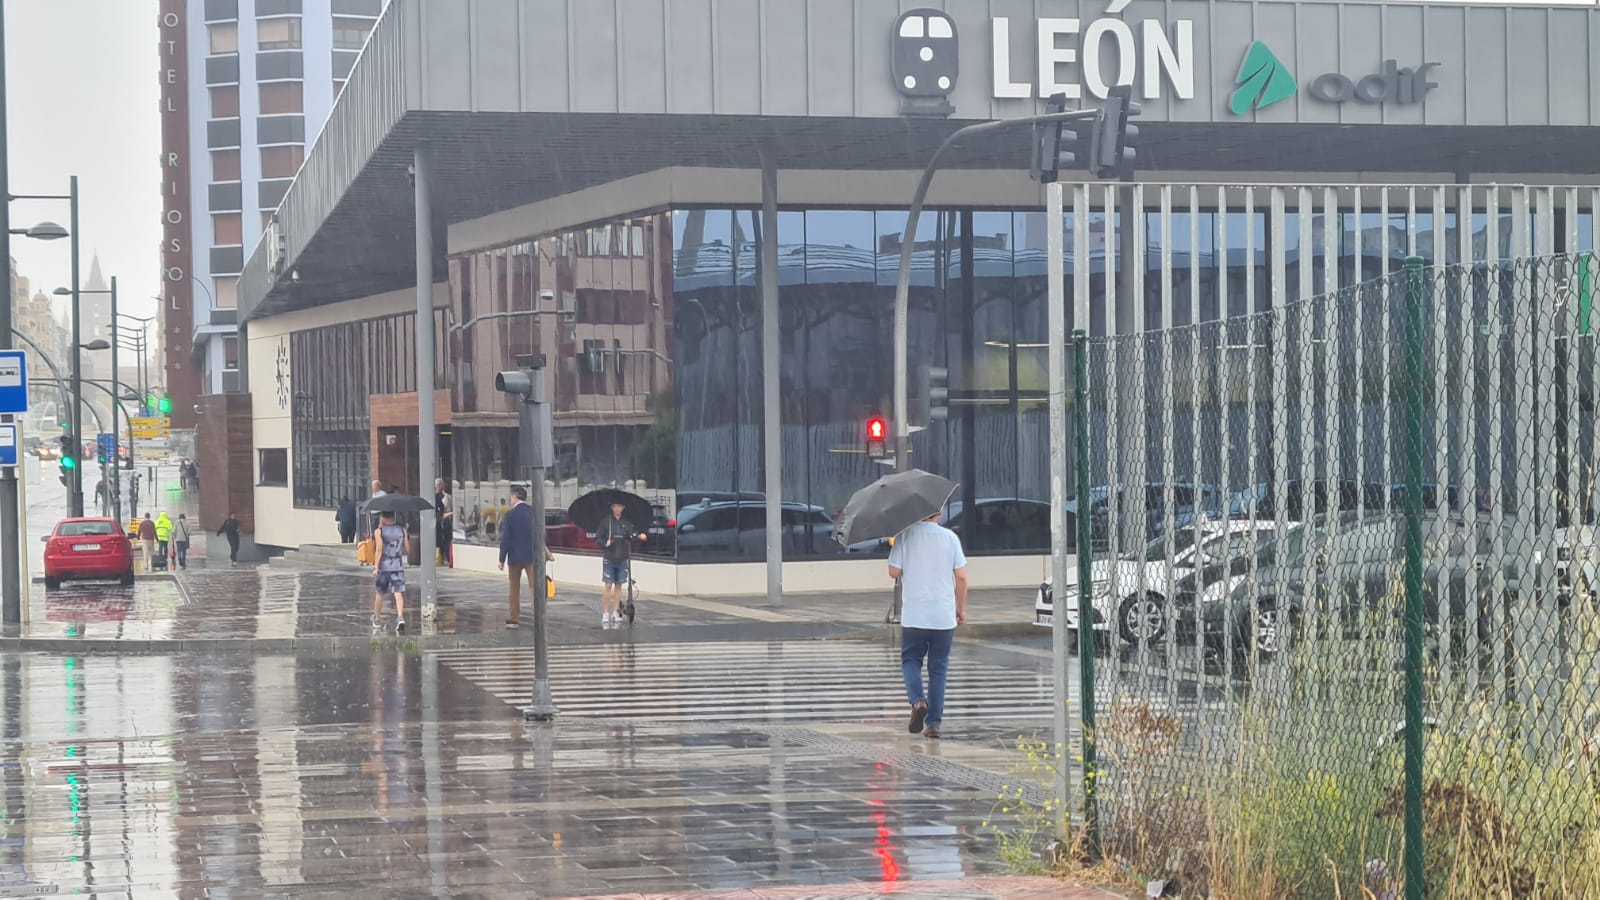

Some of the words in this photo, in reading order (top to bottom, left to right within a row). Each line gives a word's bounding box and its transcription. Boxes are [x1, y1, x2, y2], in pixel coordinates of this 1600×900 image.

[993, 0, 1193, 99] LEÓN
[1310, 60, 1441, 104] adif
[167, 152, 183, 310] RIOSOL
